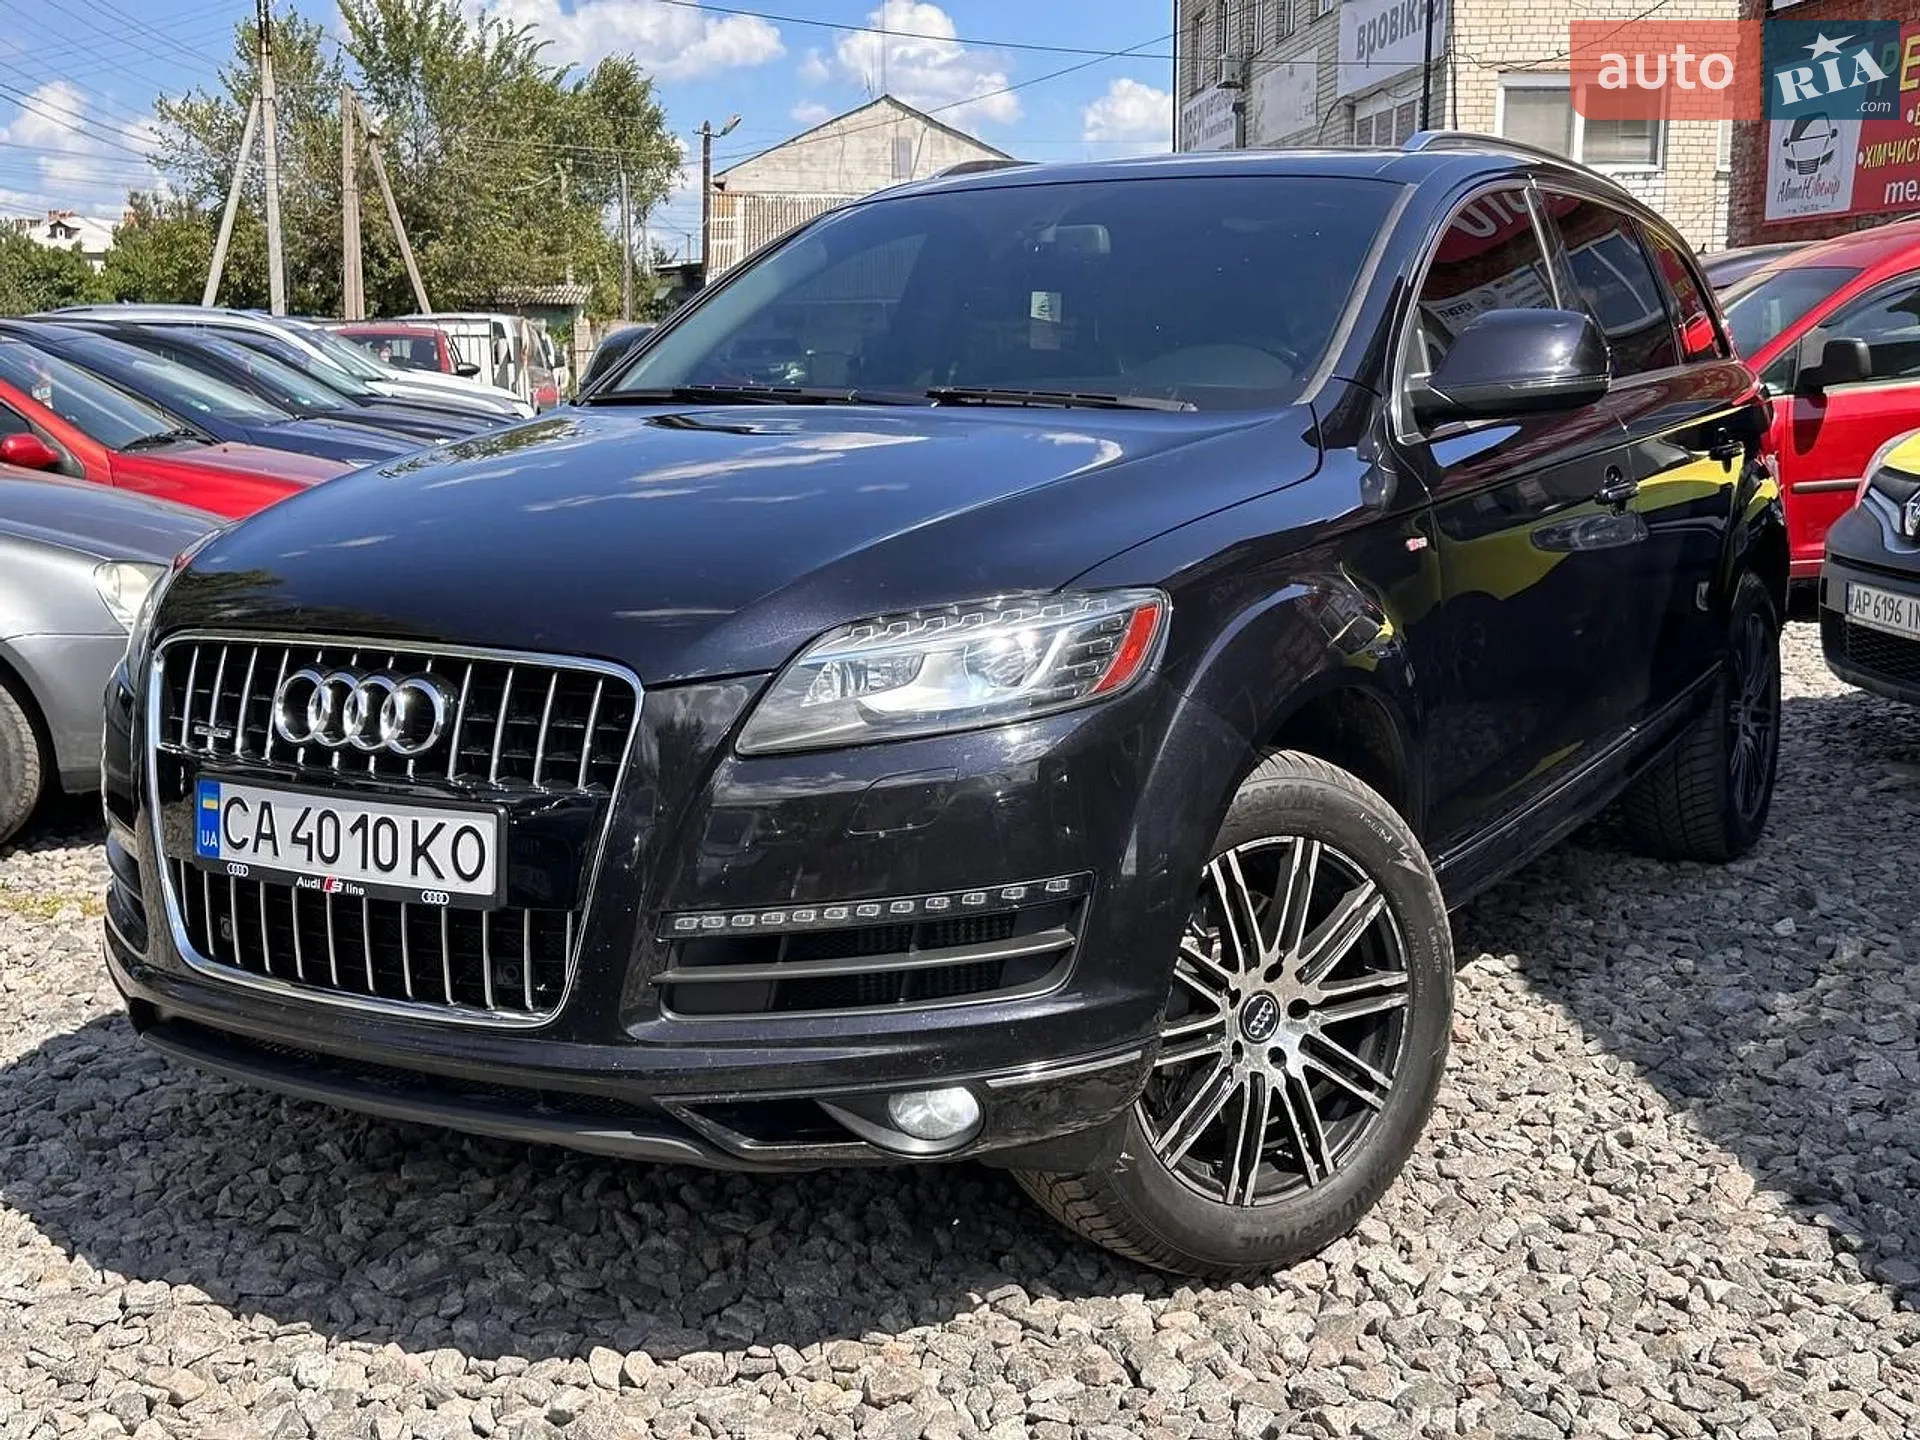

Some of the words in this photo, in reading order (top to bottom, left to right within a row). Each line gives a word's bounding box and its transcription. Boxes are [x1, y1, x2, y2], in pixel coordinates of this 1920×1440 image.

[1854, 589, 1871, 614] AP
[1873, 594, 1902, 624] 6196
[202, 834, 218, 848] UA
[223, 796, 279, 858] CA
[291, 806, 399, 873] 4010
[411, 818, 486, 883] KO
[295, 876, 321, 889] Audi
[346, 882, 366, 896] line
